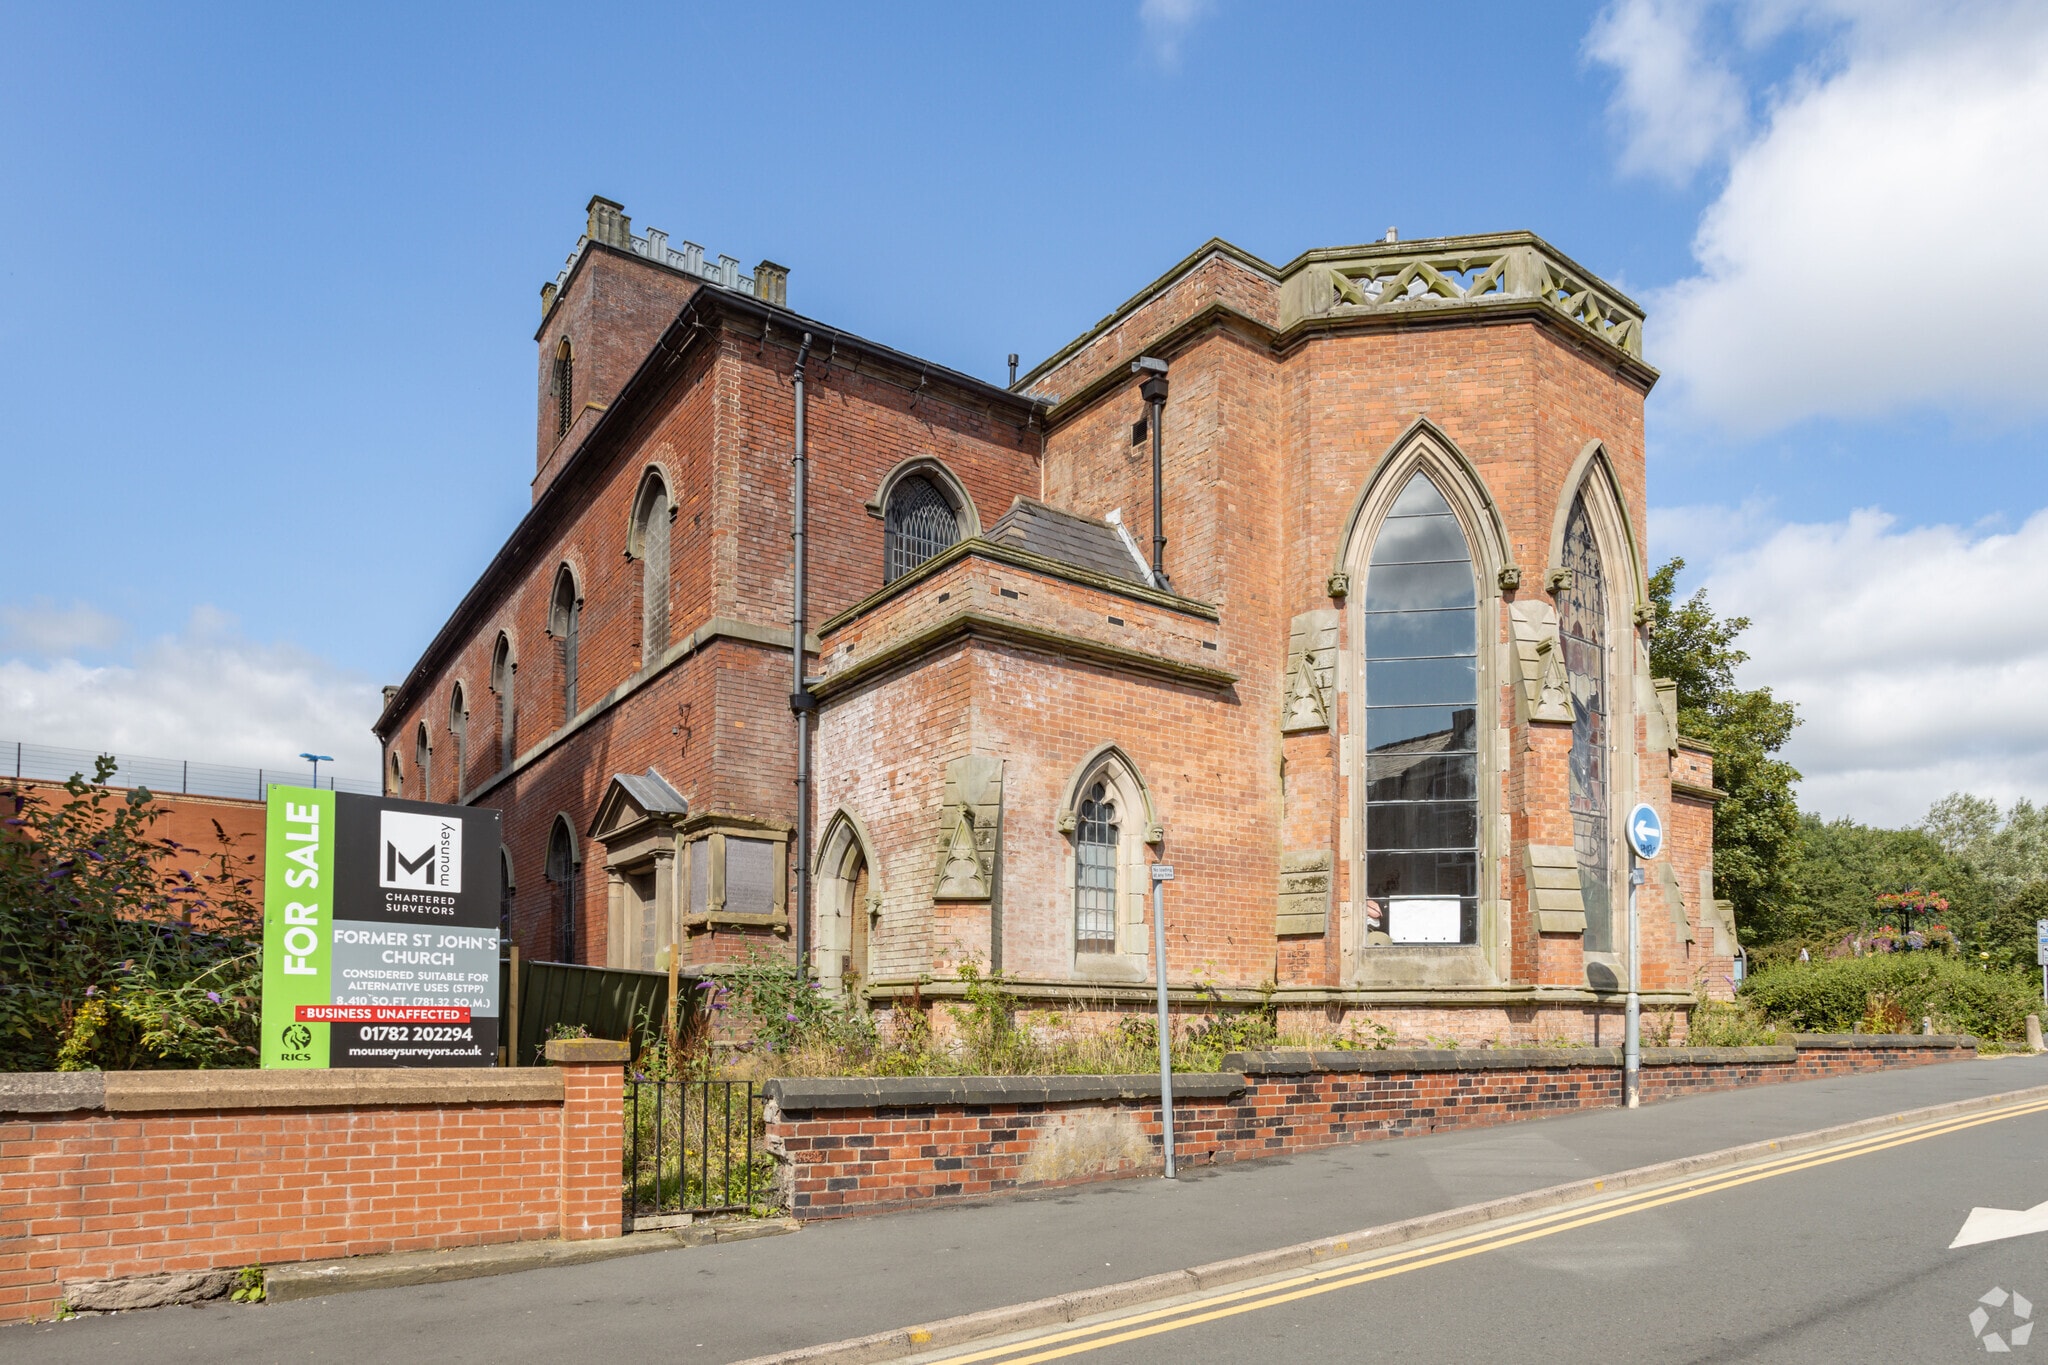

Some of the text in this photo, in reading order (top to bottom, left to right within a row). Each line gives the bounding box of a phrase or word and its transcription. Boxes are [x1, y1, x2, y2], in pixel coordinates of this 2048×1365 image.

[440, 822, 456, 886] mounsey
[284, 802, 320, 975] FOR SALE
[386, 892, 456, 905] CHARTERED
[386, 903, 455, 916] SURVEYORS
[334, 930, 408, 946] FORMER
[412, 934, 432, 947] ST
[382, 950, 454, 966] CHURCH
[342, 969, 488, 982] CONSIDERED SUITABLE FOR
[348, 982, 484, 994] ALTERNATIVE USES (STPP)
[306, 1008, 460, 1020] BUSINESS UNAFFECTED
[360, 1026, 474, 1042] 01782 202294
[281, 1053, 312, 1061] RICS
[349, 1045, 482, 1060] mounseysurveyors.co.uk
